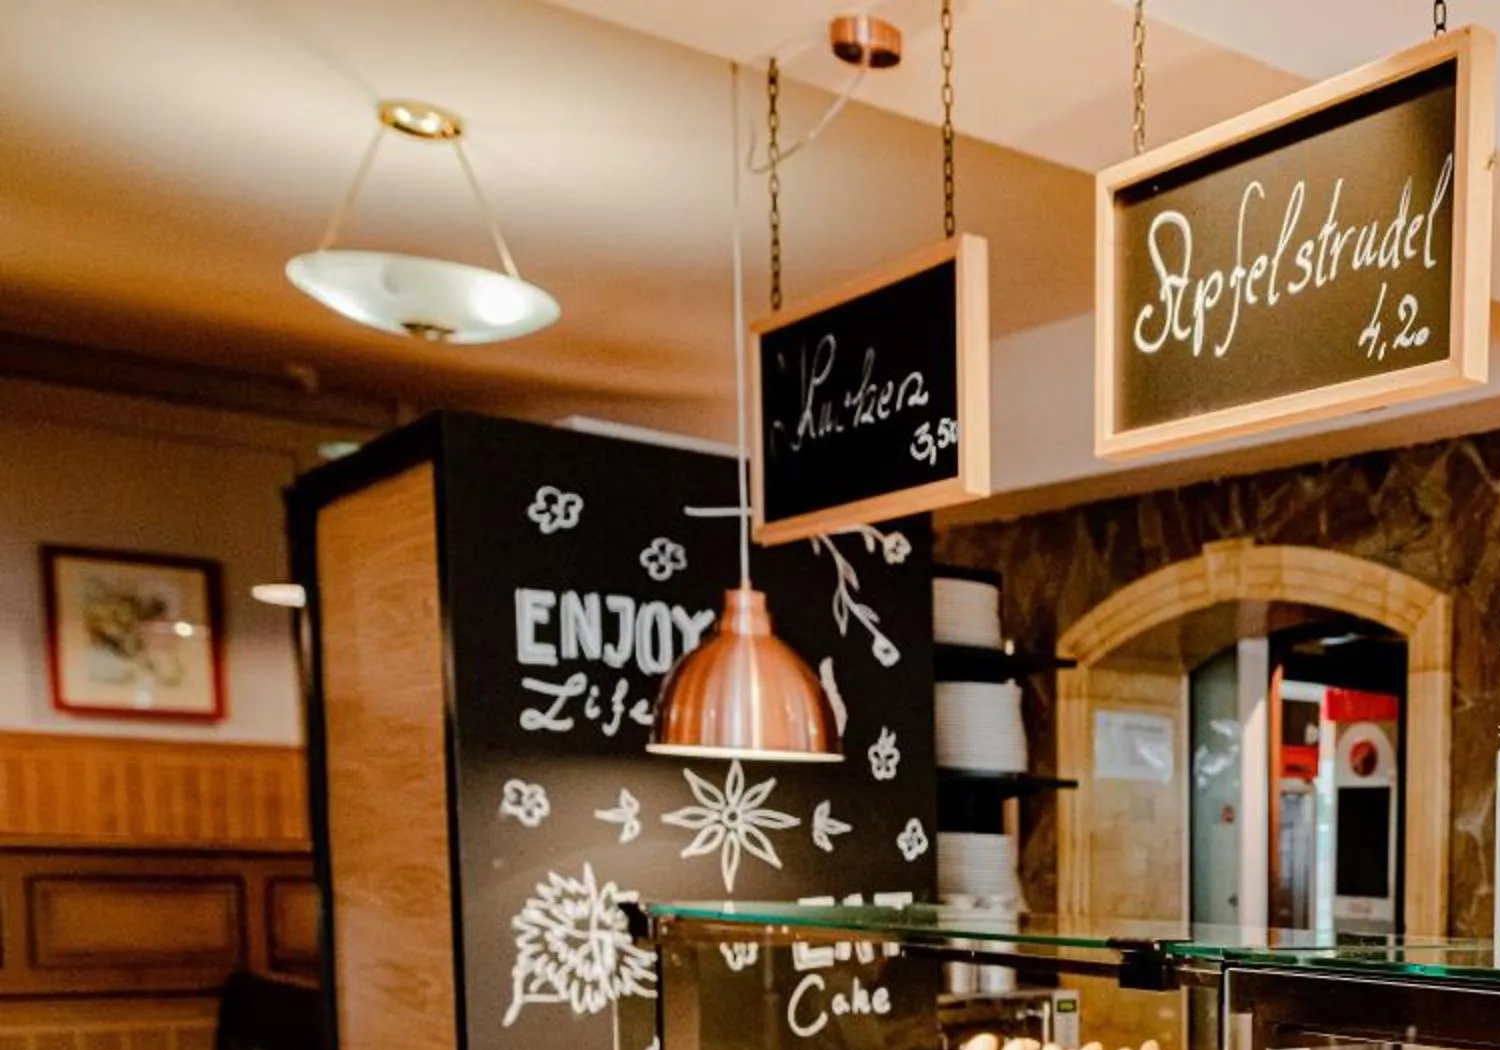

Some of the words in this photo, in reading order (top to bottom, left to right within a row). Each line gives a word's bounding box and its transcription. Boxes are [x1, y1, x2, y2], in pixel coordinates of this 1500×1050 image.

[1134, 153, 1453, 357] Apfelstrudel
[514, 587, 717, 676] ENJOY
[520, 673, 653, 736] Life
[787, 973, 892, 1038] Cake
